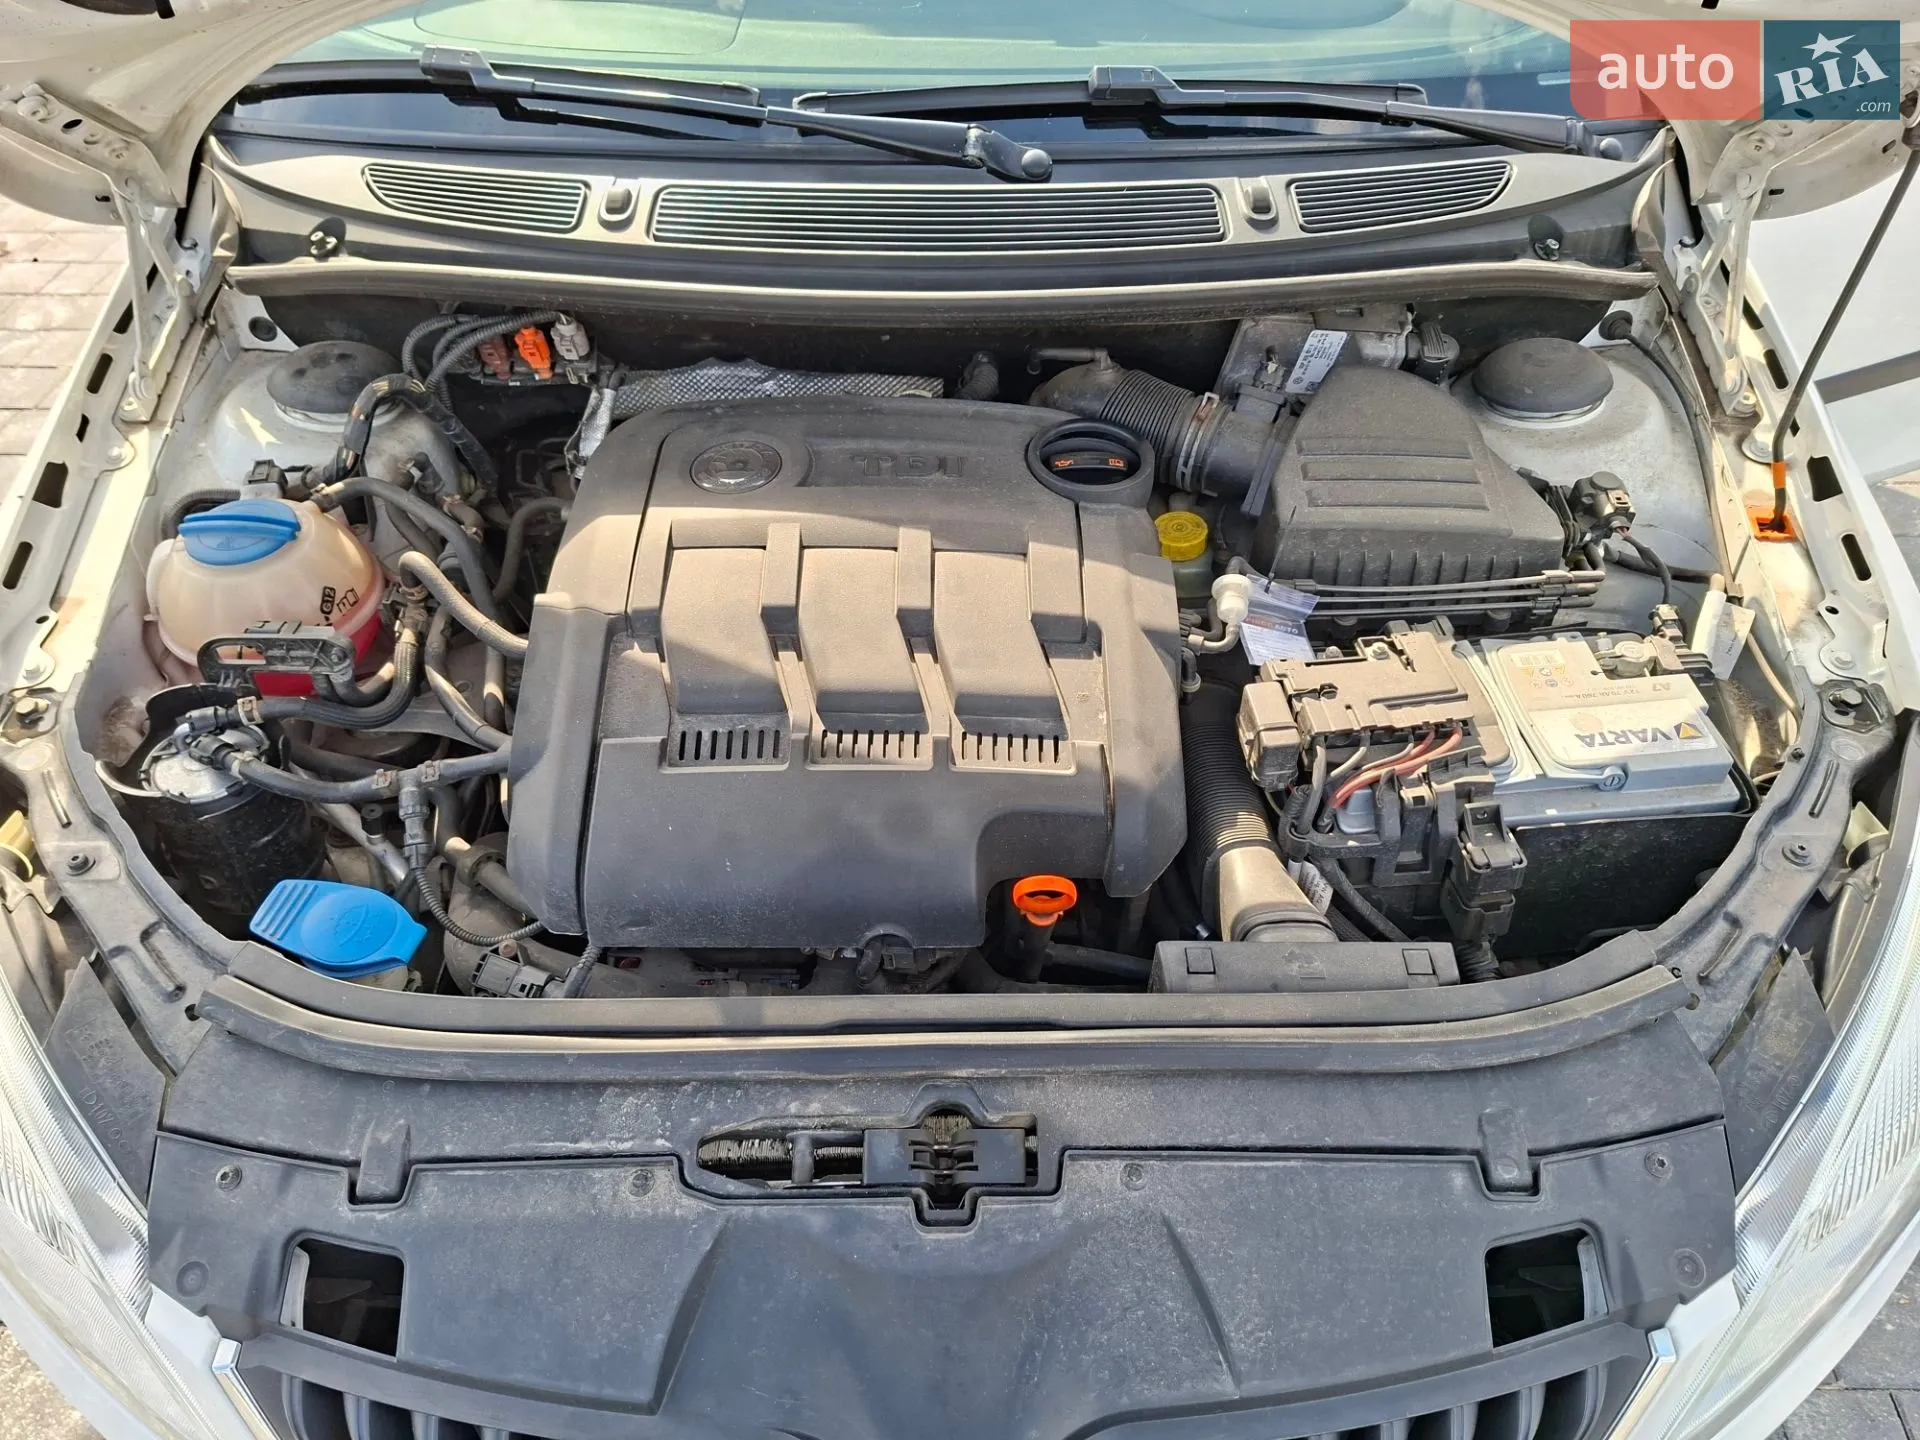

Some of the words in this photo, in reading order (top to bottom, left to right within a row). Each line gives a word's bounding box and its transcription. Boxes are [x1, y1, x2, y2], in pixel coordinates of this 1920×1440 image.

[848, 455, 968, 478] TDI
[322, 587, 335, 612] G12
[1574, 727, 1673, 748] VARTA
